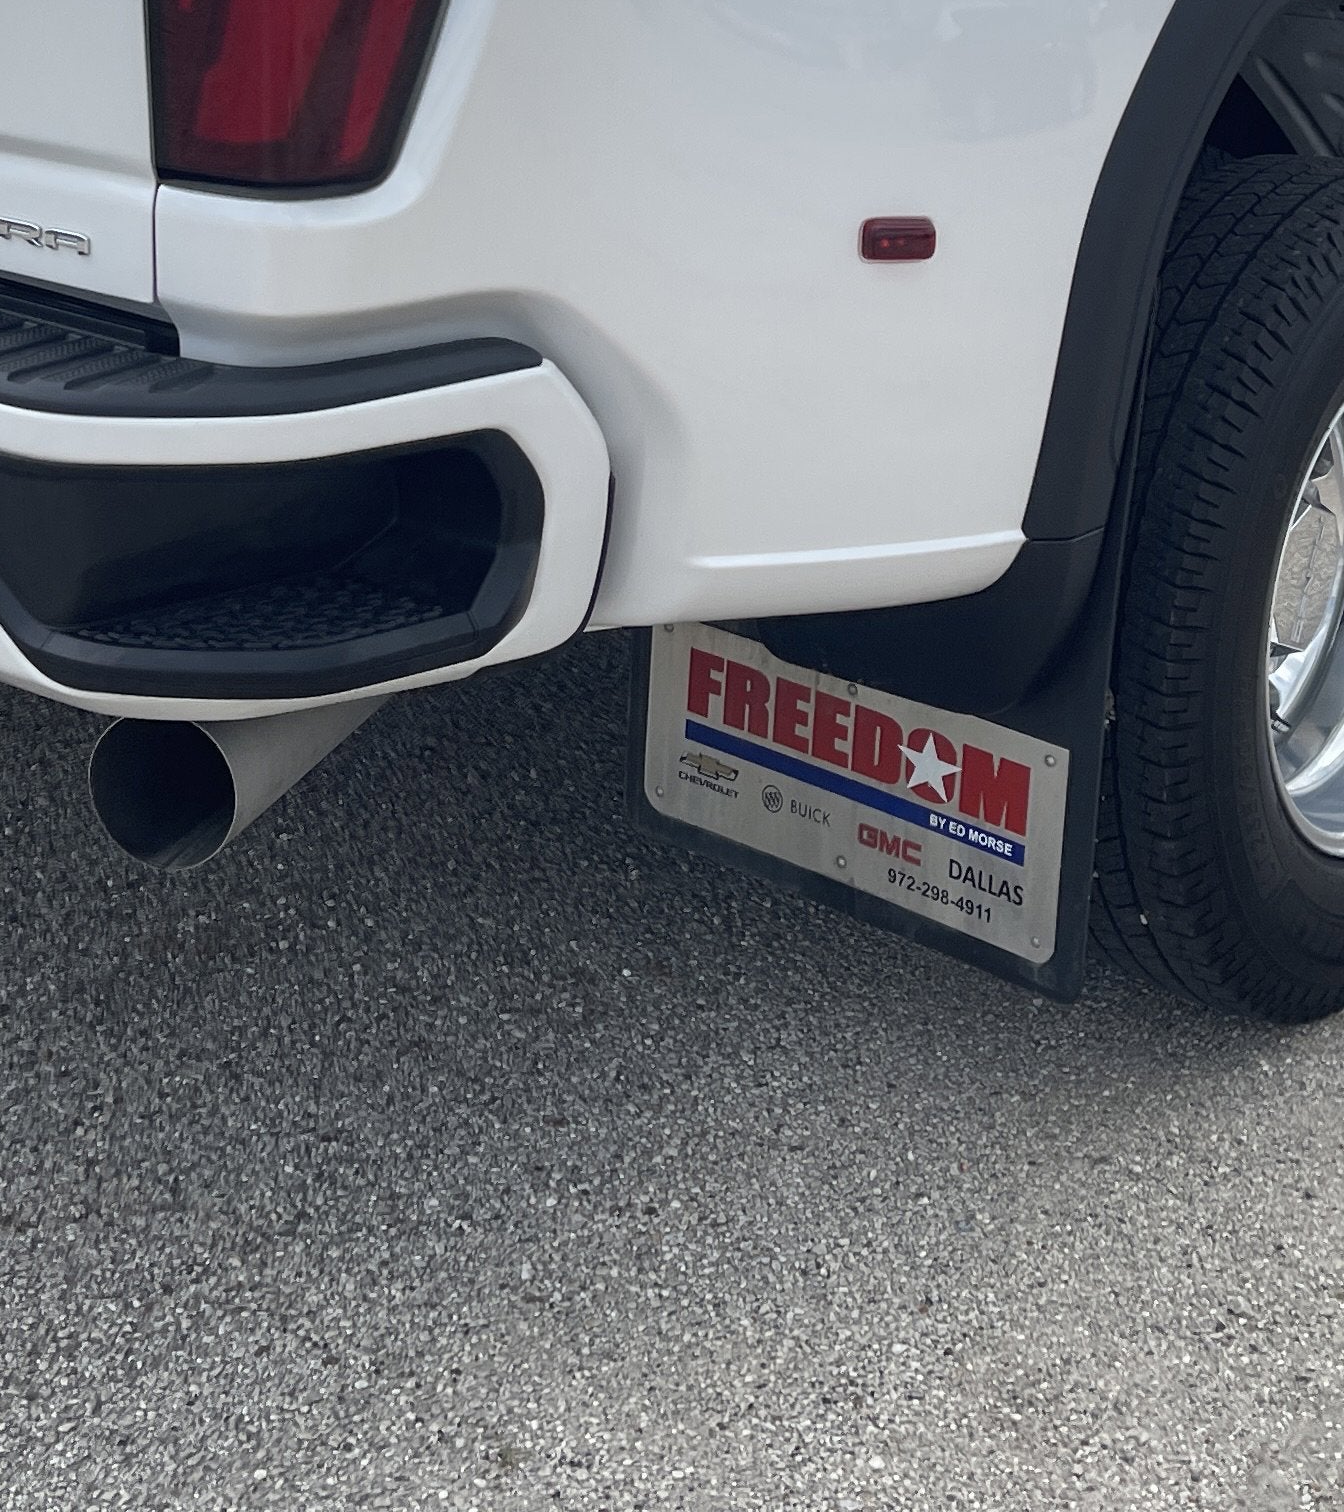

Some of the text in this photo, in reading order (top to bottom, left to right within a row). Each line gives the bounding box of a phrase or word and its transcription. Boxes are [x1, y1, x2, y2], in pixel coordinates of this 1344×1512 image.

[687, 646, 1031, 837] FREEDOM
[678, 770, 739, 800] CHEVROLET
[790, 799, 831, 828] BUICK
[929, 813, 1013, 857] BY ED MORSE
[858, 822, 922, 866] GMC
[887, 868, 992, 923] 972-298-4911
[949, 858, 1023, 906] DALLAS
